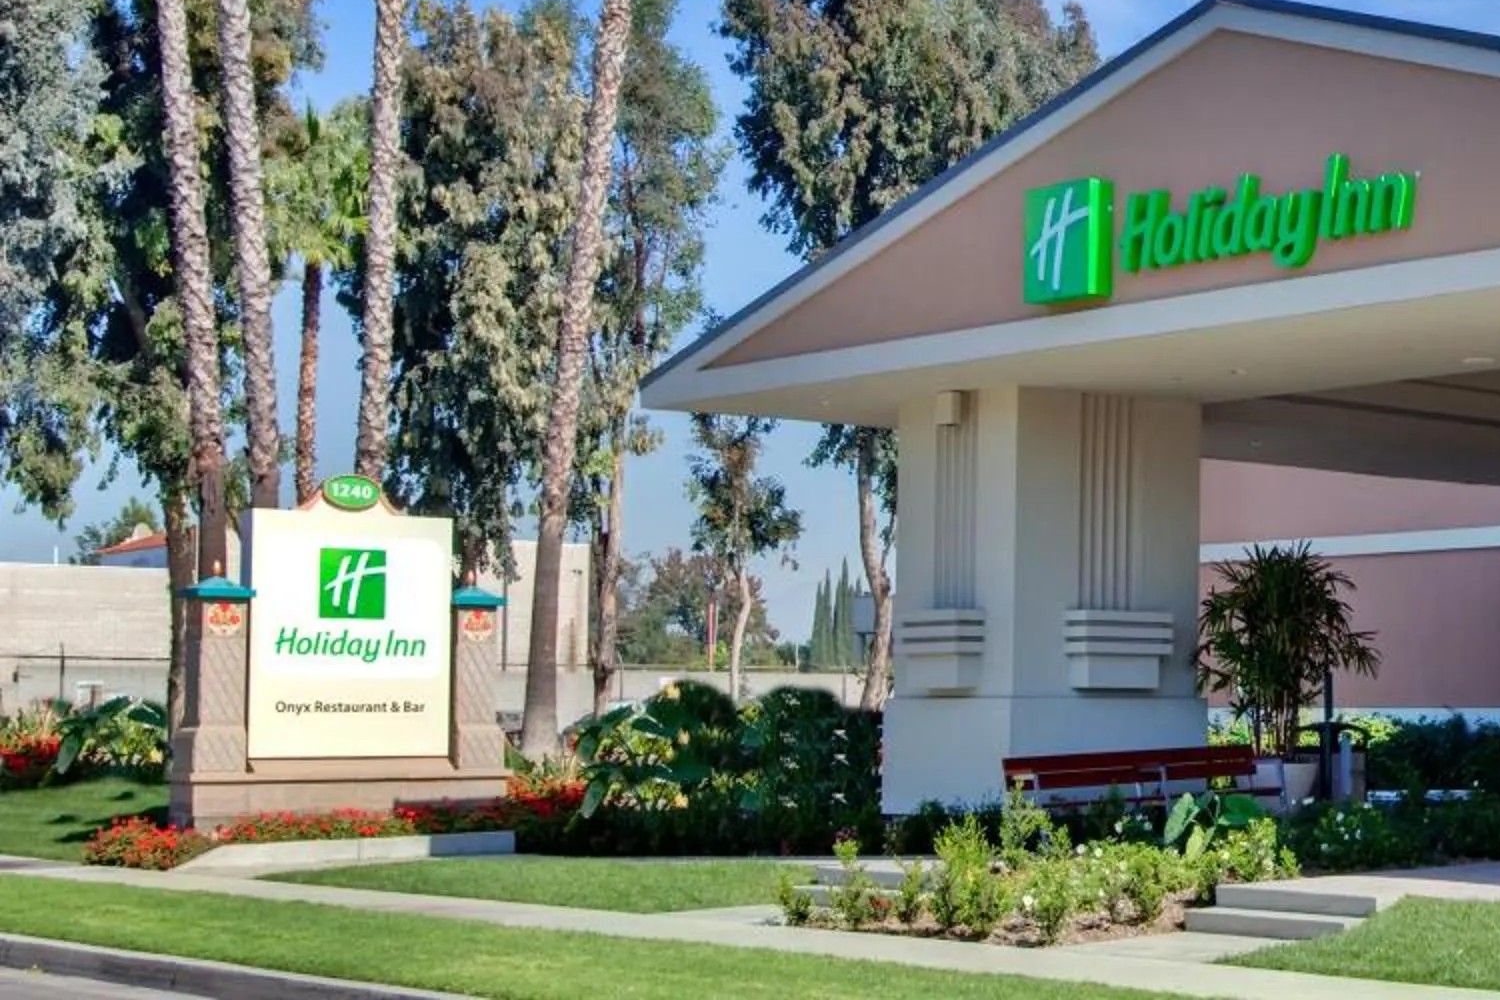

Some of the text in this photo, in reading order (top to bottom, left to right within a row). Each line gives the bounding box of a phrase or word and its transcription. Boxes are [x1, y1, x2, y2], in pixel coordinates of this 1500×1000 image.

[1120, 152, 1416, 272] Holiday Inn
[332, 483, 373, 499] 1240
[275, 627, 426, 663] Holiday Inn
[275, 700, 425, 715] Onyx Restaurant & Bar
